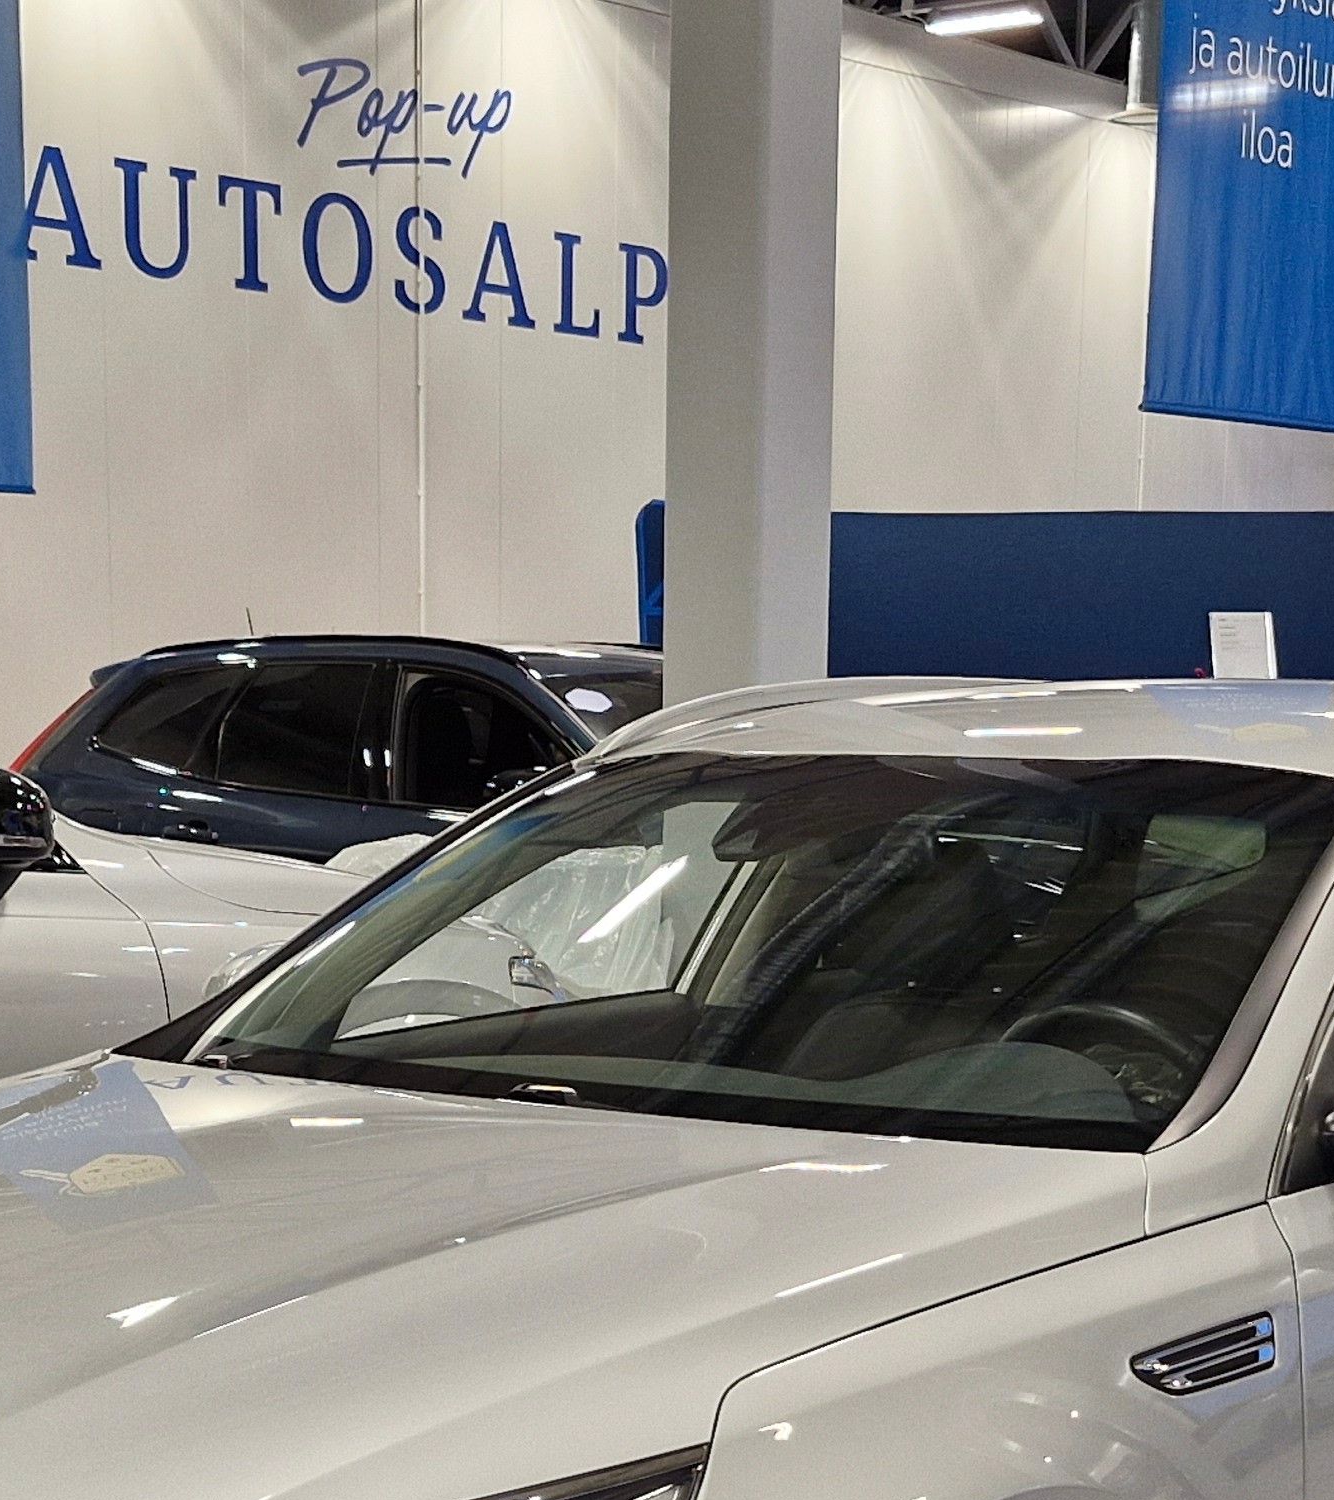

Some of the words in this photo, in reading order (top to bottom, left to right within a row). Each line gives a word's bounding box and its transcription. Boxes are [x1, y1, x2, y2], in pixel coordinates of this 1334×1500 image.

[1188, 12, 1216, 75] ja
[296, 57, 513, 180] Pop-up
[1240, 108, 1294, 169] iloa
